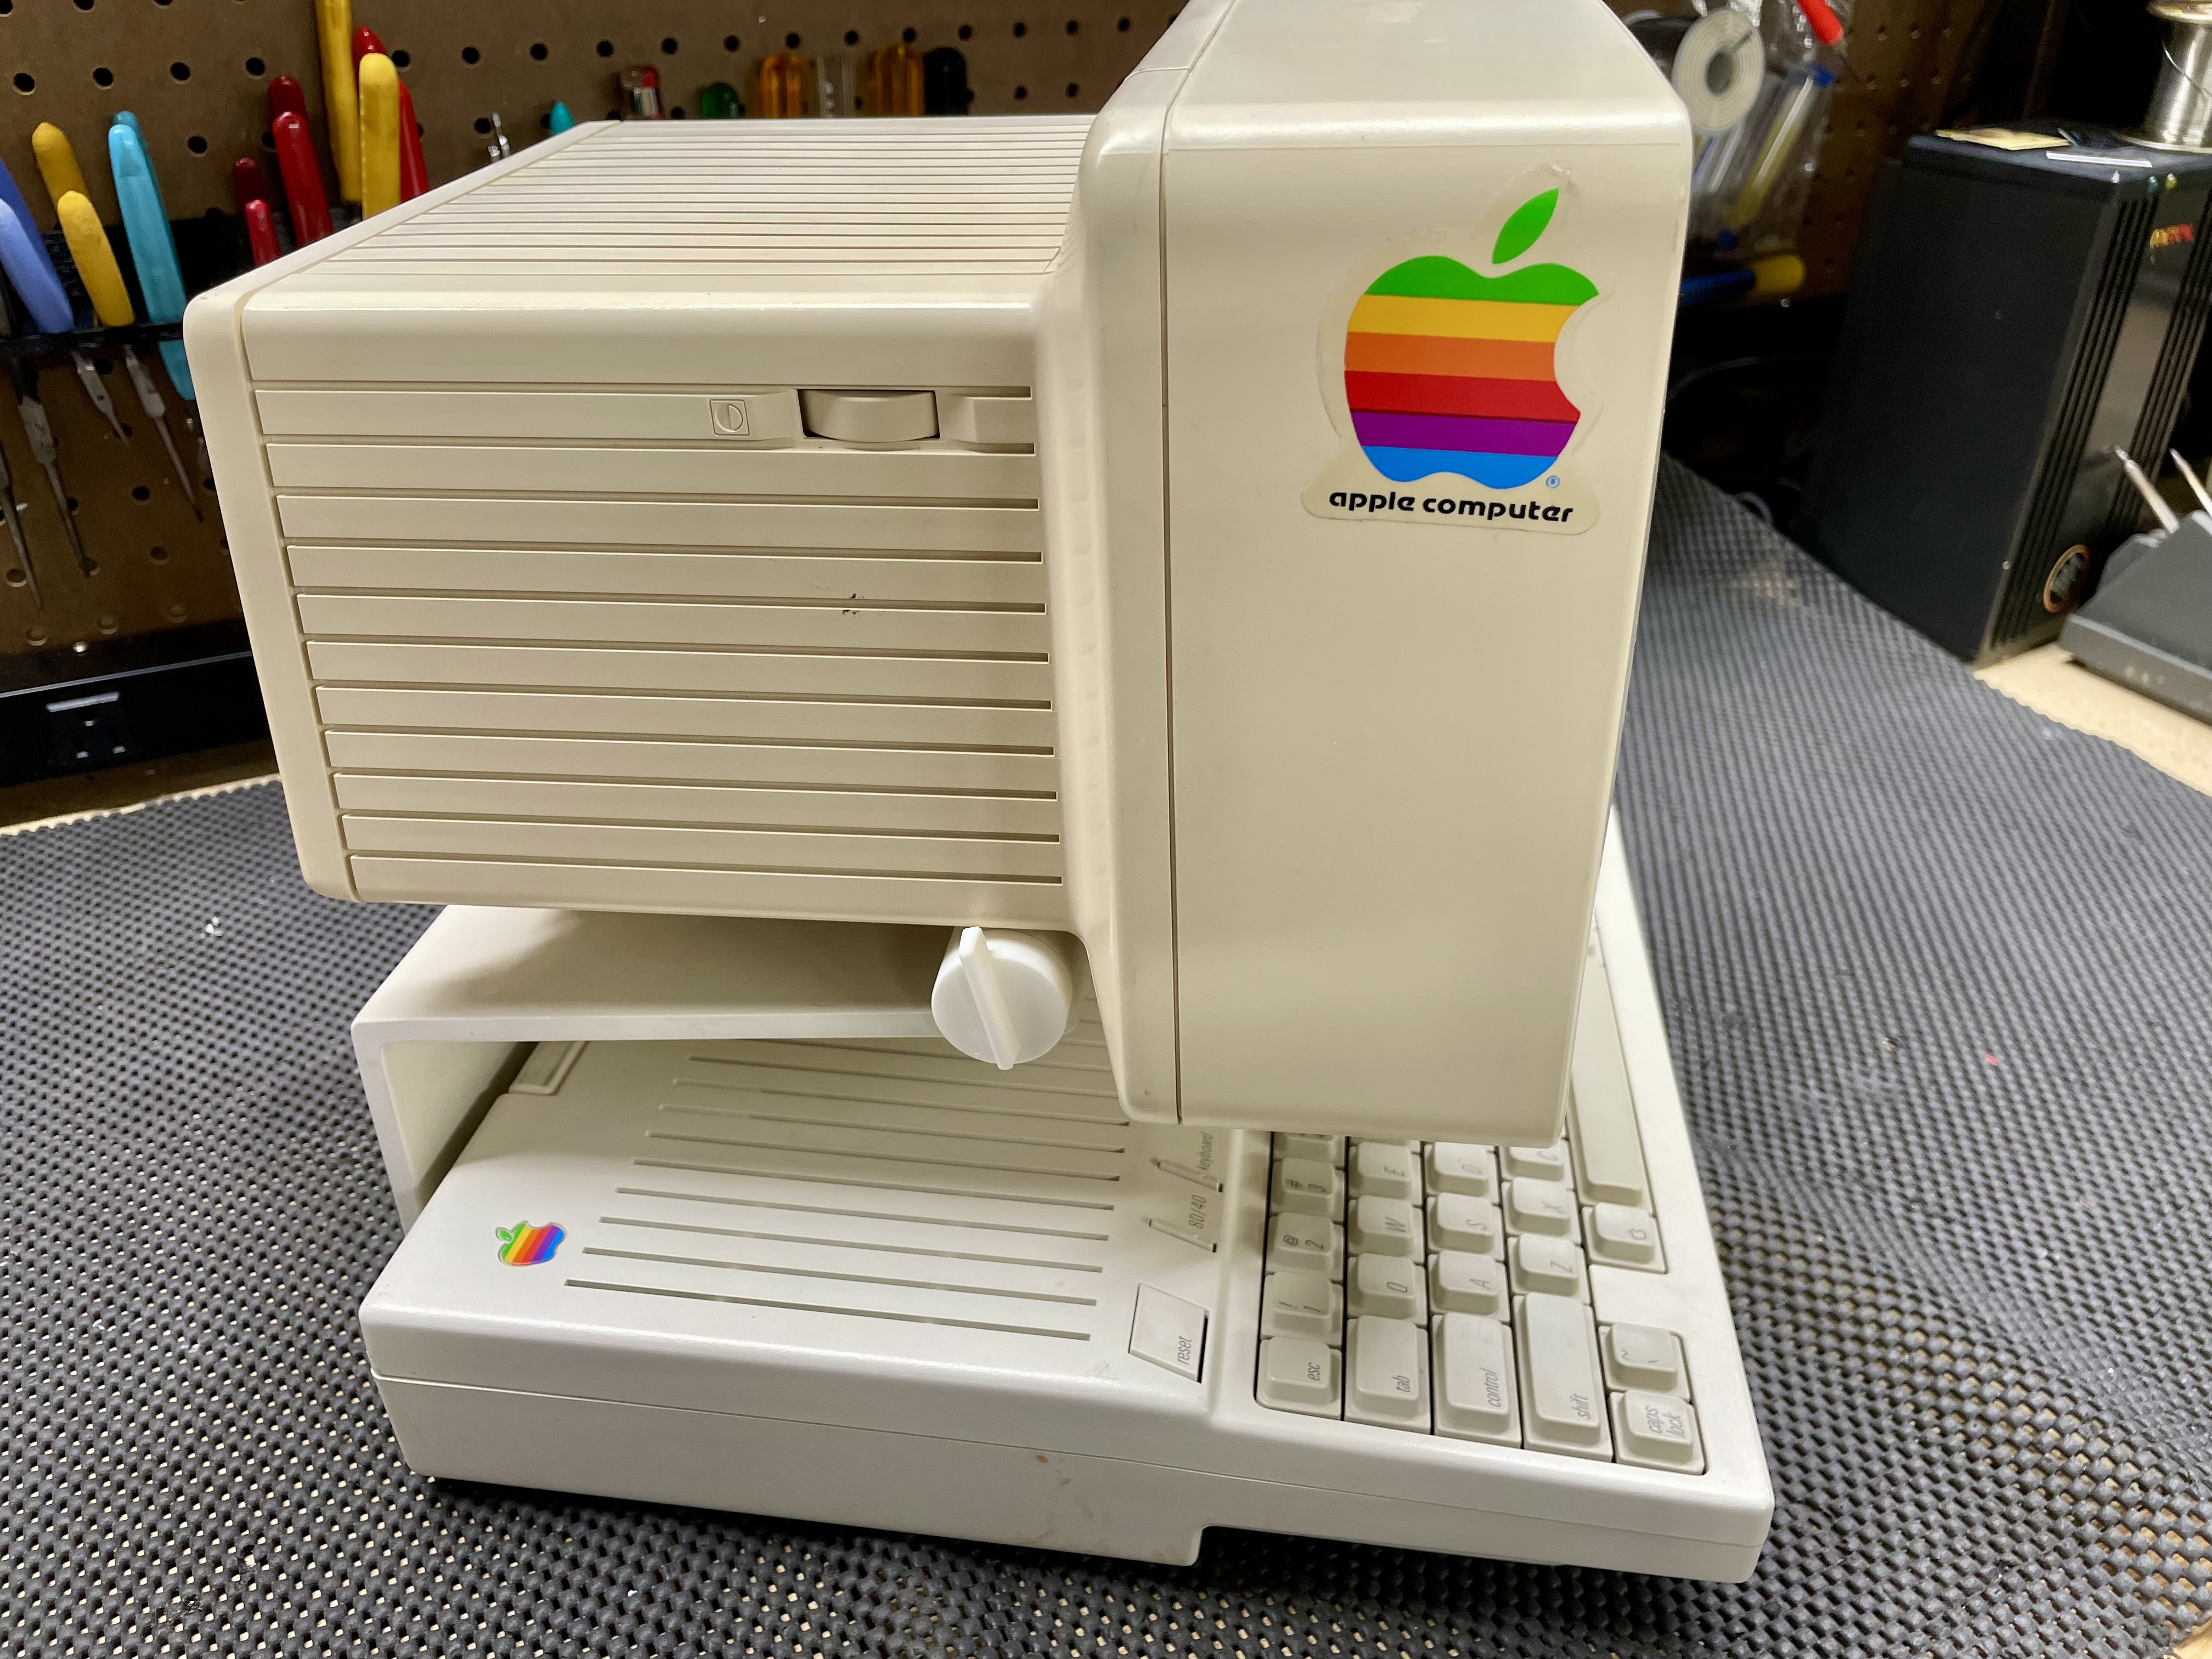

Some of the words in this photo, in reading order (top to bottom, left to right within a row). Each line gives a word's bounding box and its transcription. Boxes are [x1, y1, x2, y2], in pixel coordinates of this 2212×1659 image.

[1329, 492, 1415, 512] apple
[1423, 498, 1573, 522] computer
[1195, 1131, 1214, 1171] keyboard
[1384, 1166, 1404, 1176] E
[1188, 1195, 1206, 1229] 80/40
[1385, 1216, 1406, 1232] W
[1465, 1219, 1486, 1231] S
[1283, 1235, 1298, 1246] @
[1305, 1239, 1324, 1249] 2
[1550, 1260, 1572, 1273] Z
[1469, 1278, 1491, 1290] A
[1177, 1336, 1192, 1365] reset
[1307, 1362, 1321, 1381] esc
[1391, 1375, 1410, 1392] tab
[1479, 1367, 1502, 1407] control
[1570, 1393, 1591, 1419] shift
[1645, 1405, 1664, 1434] caps
[1662, 1412, 1686, 1437] lock
